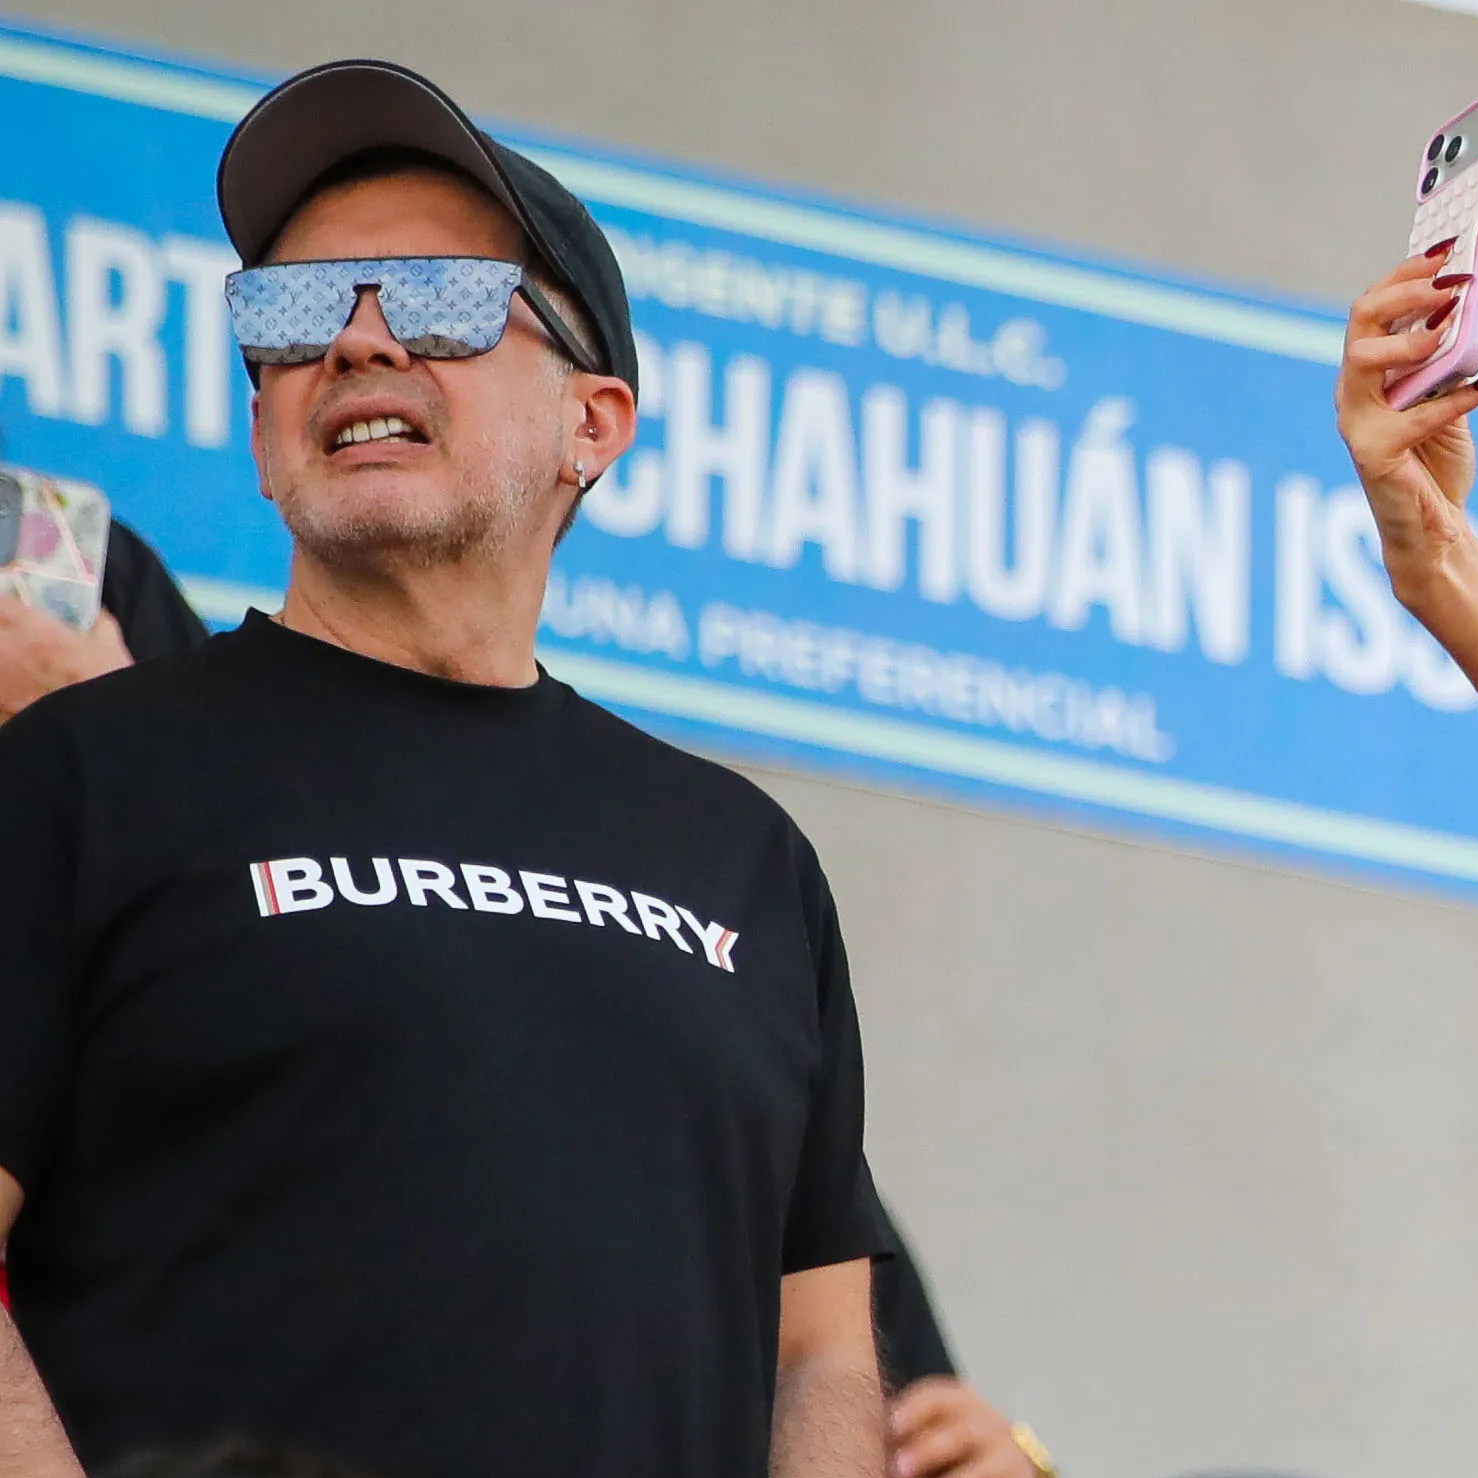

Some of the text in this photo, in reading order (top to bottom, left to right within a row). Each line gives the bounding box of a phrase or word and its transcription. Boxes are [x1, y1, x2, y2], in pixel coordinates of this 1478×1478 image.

[580, 330, 1250, 665] CHAHUÁN
[698, 600, 1177, 763] PREFERENCIAL
[249, 856, 740, 973] BURBERRY
